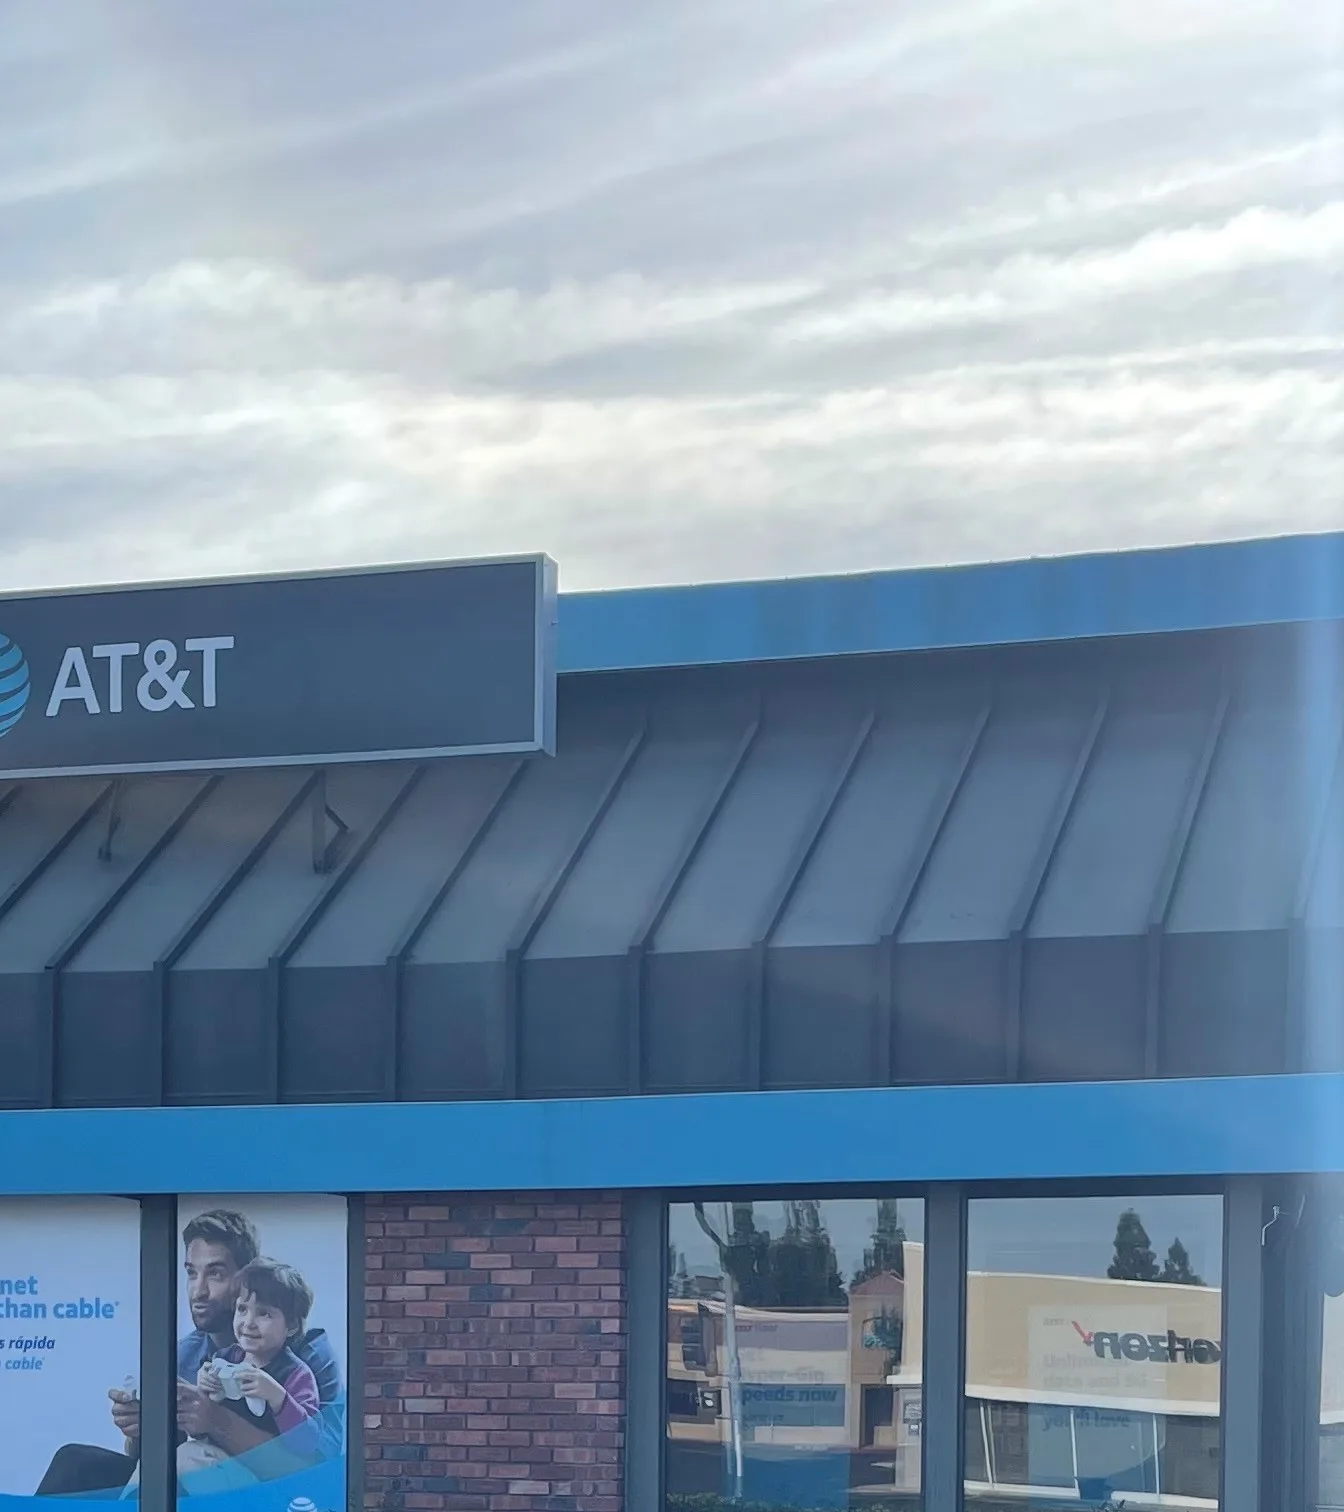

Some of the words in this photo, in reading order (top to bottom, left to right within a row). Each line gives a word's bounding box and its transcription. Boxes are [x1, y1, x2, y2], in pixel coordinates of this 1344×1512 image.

[46, 636, 235, 717] AT&T
[8, 1335, 56, 1353] rápida
[741, 1386, 795, 1406] peeds
